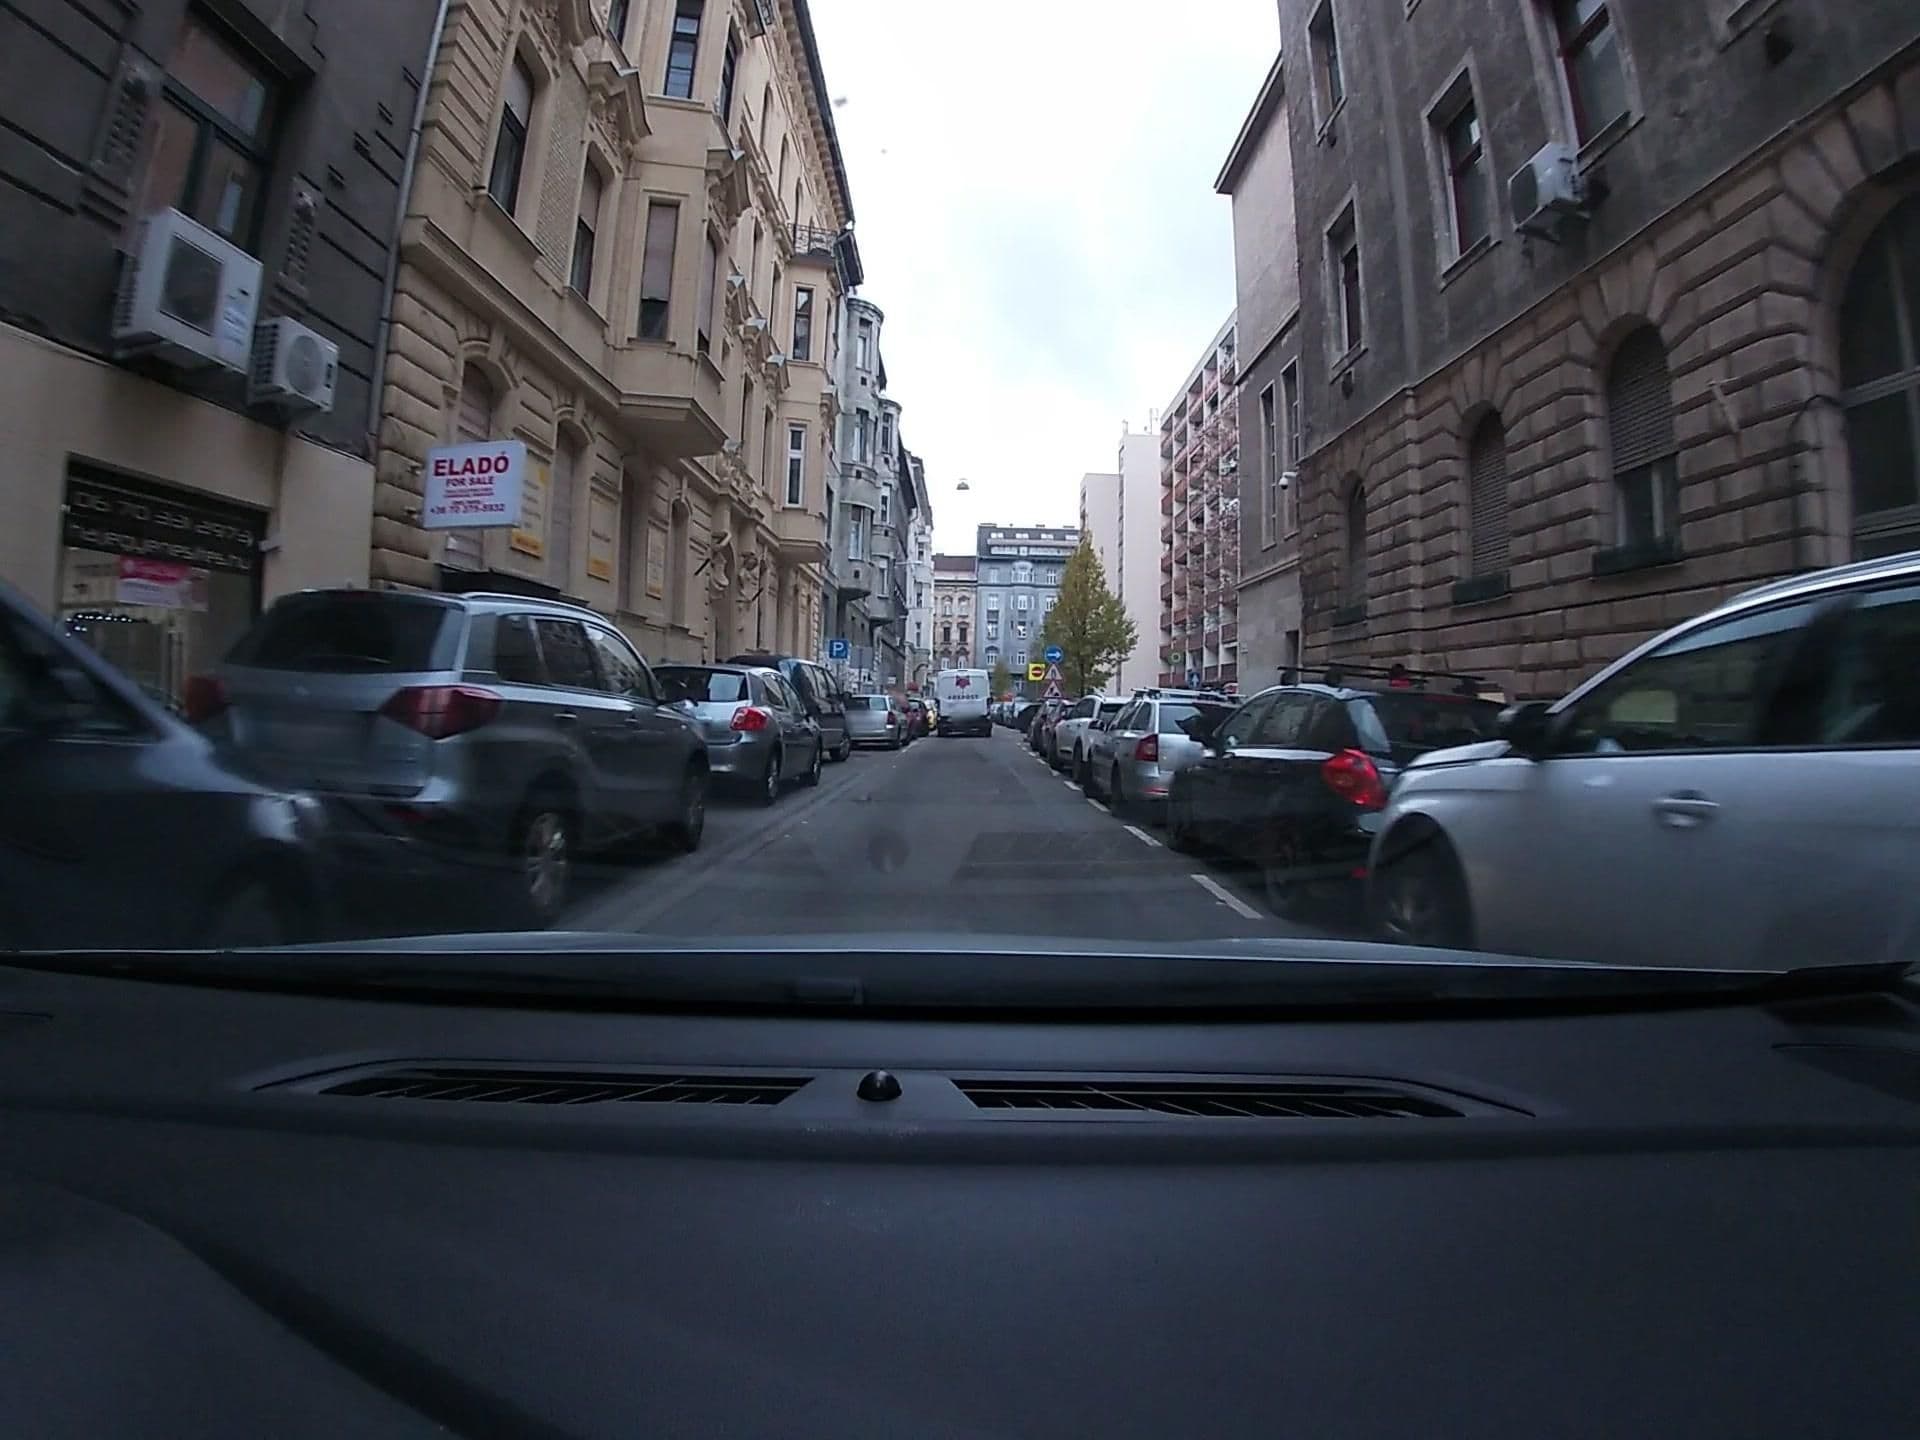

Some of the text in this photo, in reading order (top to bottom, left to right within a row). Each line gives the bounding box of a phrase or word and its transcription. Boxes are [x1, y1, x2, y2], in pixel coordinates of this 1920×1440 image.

[433, 451, 509, 476] ELADÓ
[446, 476, 494, 488] FOR SALE
[832, 641, 844, 657] P
